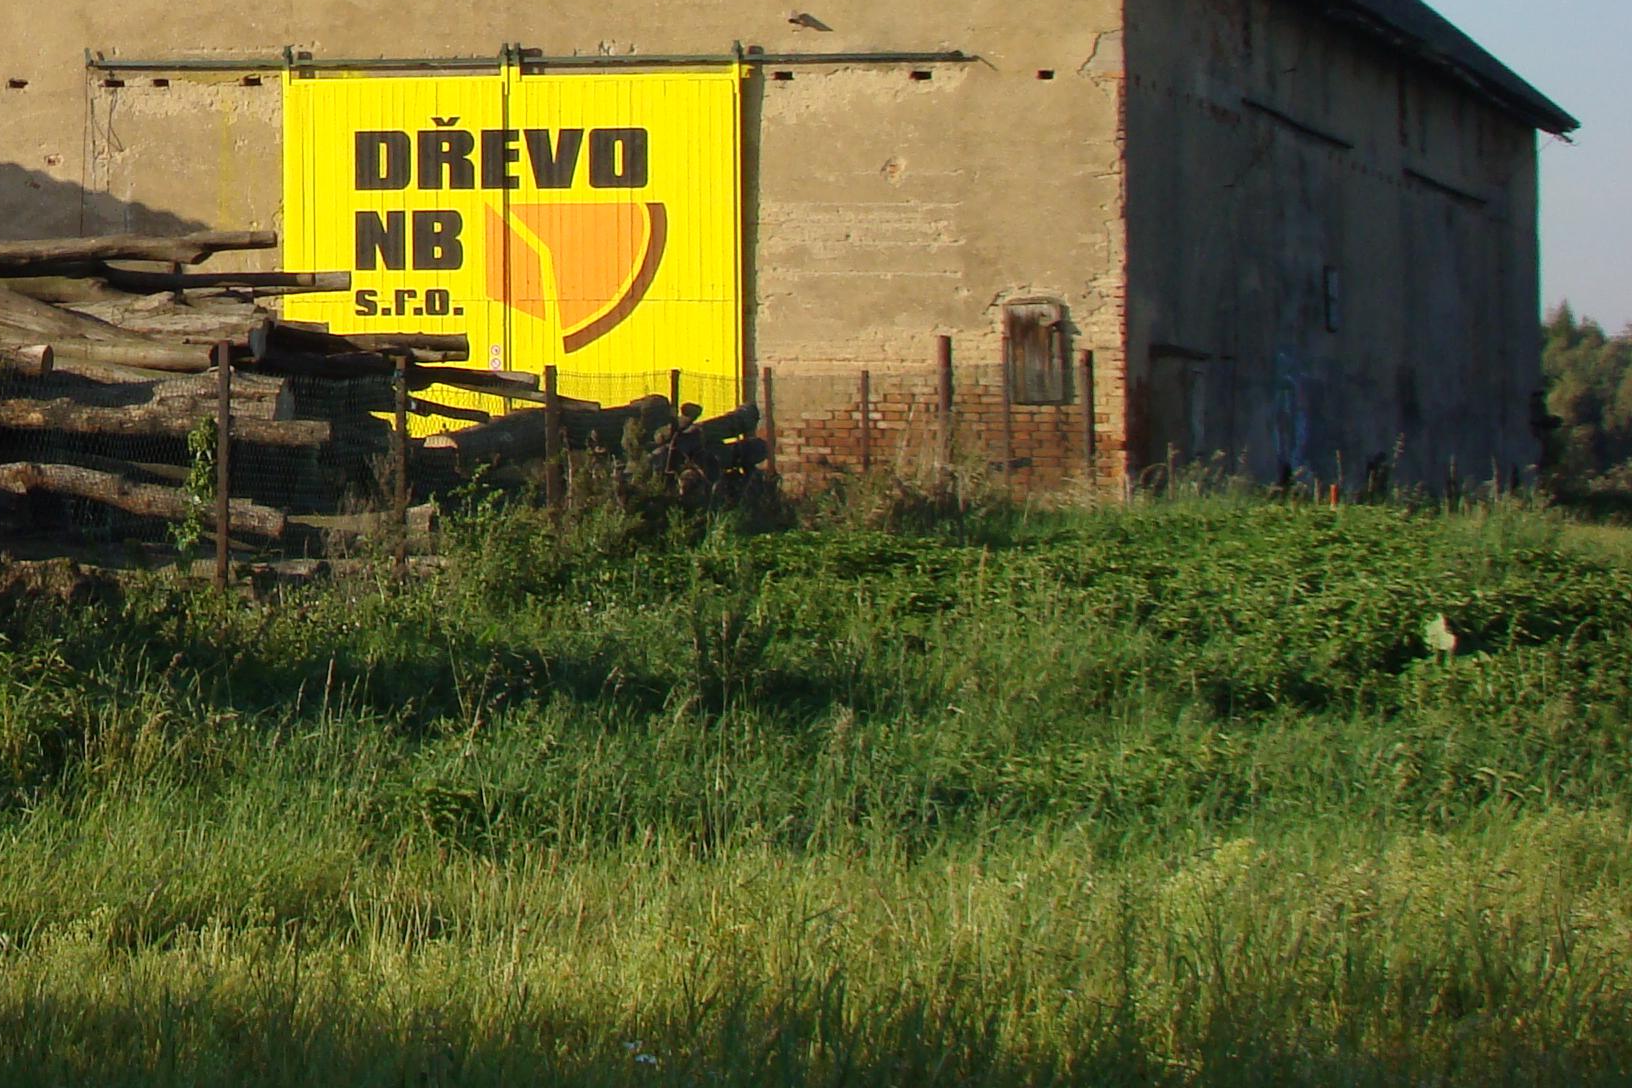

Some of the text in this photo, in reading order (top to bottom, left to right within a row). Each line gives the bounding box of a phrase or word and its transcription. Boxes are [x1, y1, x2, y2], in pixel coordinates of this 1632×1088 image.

[354, 116, 649, 190] DŘEVO
[354, 210, 464, 271] NB
[354, 288, 465, 317] s.r.o.
